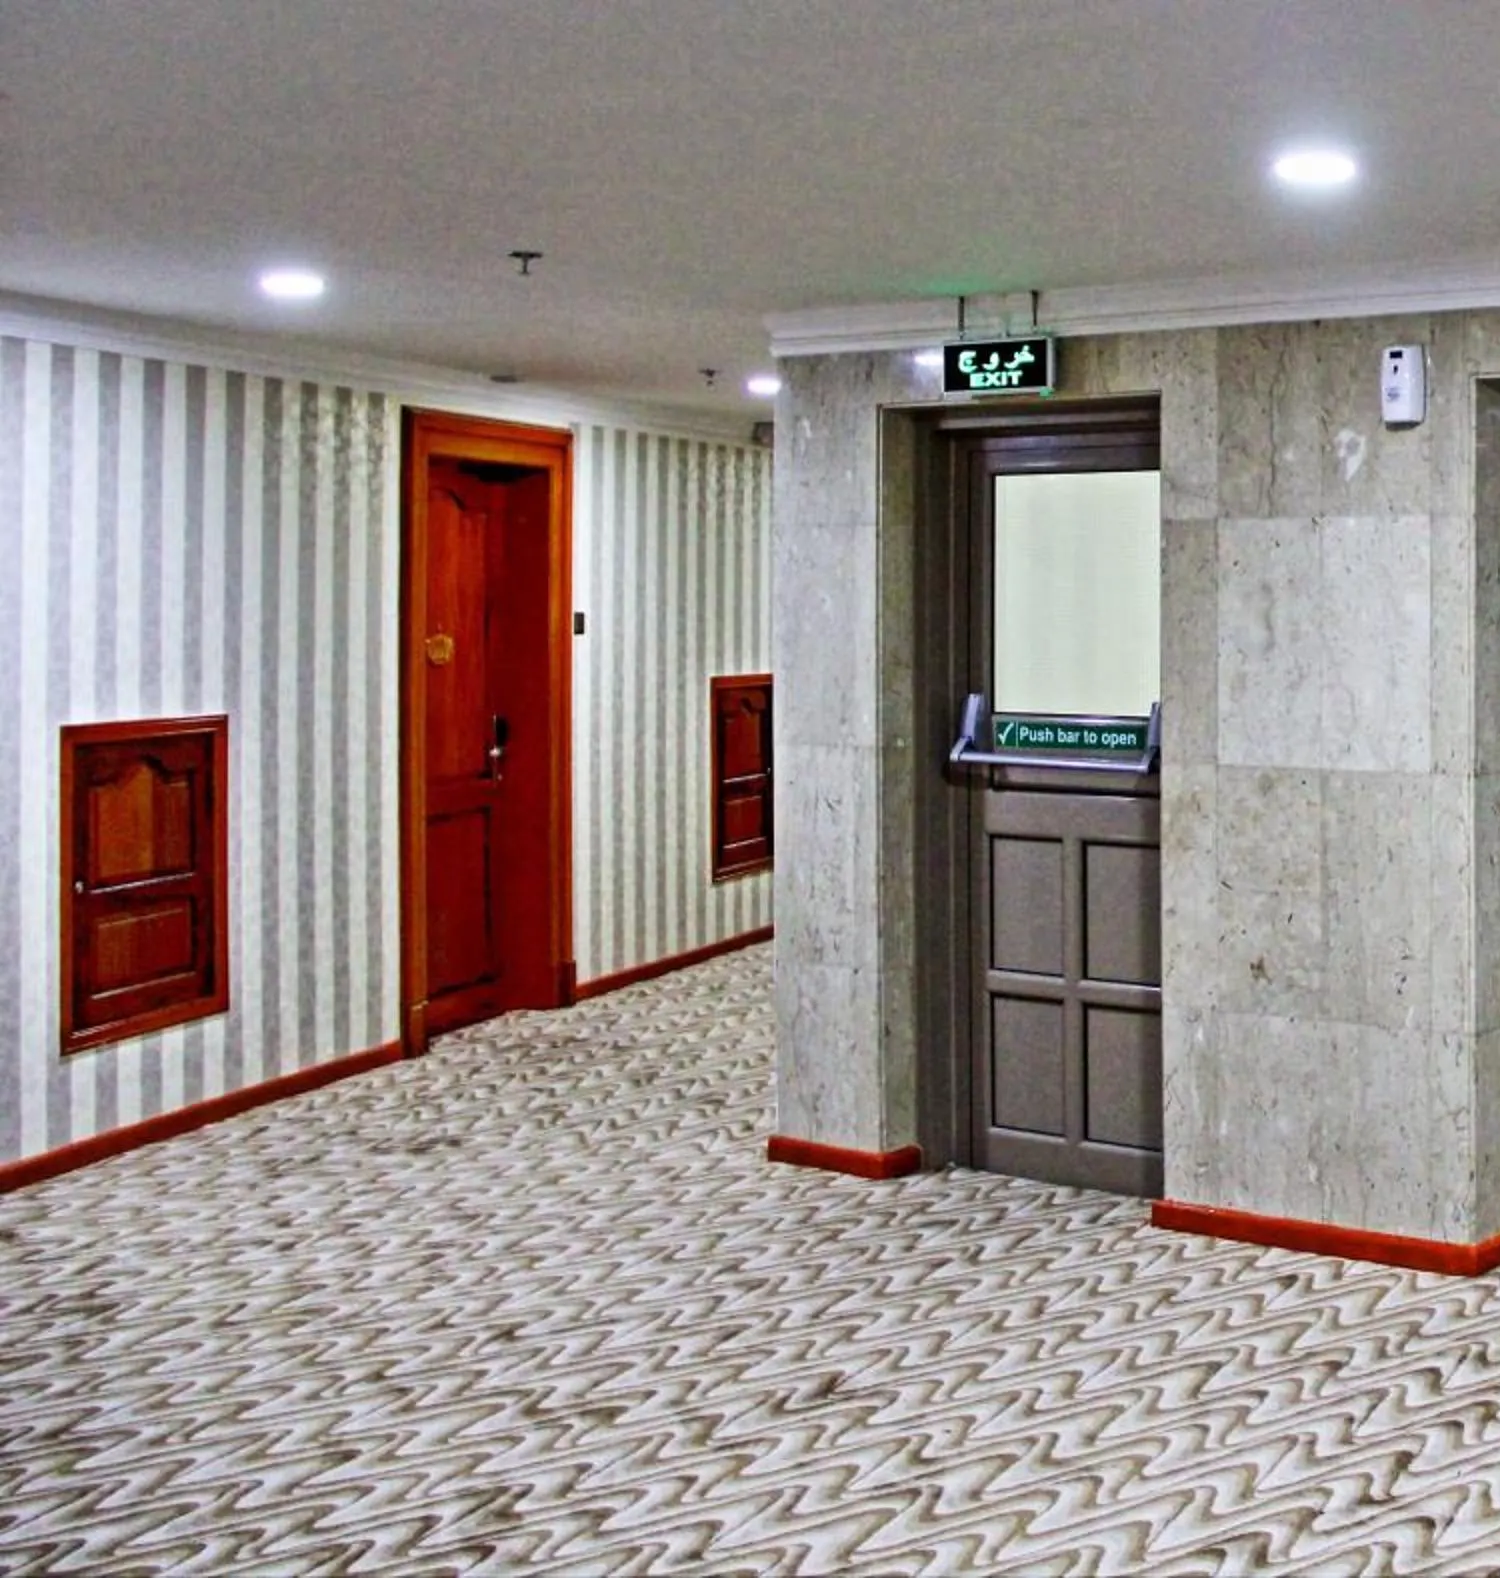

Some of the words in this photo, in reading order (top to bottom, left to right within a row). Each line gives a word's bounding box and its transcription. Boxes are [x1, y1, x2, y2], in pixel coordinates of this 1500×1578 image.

[970, 370, 1023, 387] EXIT
[1019, 727, 1053, 742] Push
[1058, 728, 1079, 743] bar
[1083, 730, 1098, 743] to
[1102, 732, 1136, 747] open
